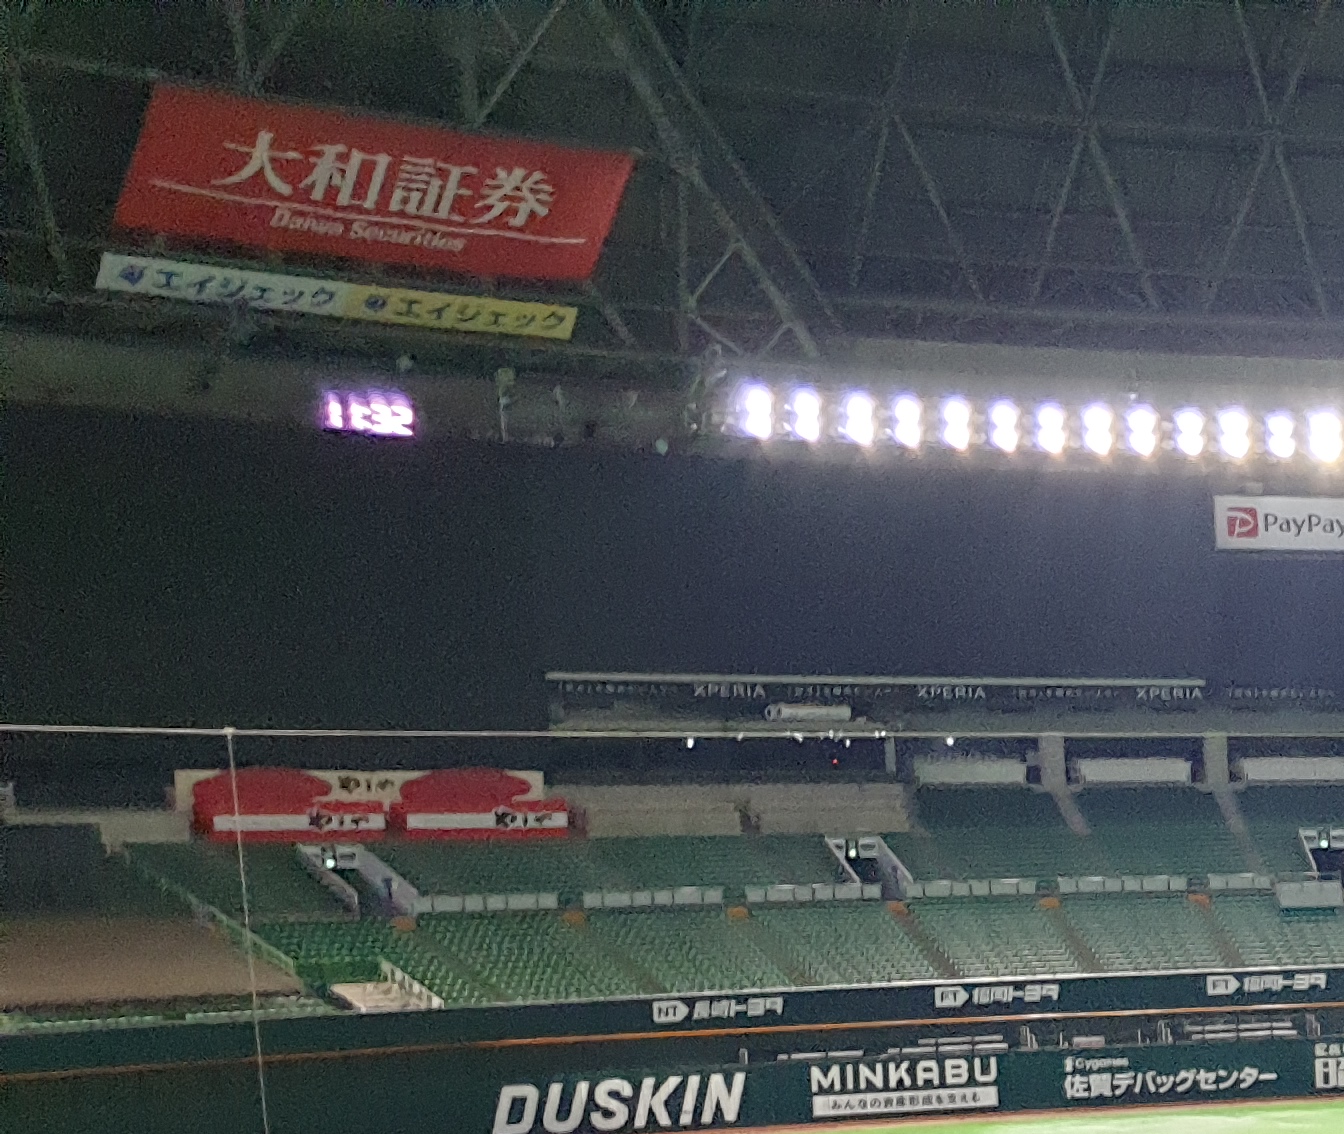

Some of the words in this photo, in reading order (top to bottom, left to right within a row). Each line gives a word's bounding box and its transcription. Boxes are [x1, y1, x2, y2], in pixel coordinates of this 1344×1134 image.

[212, 131, 556, 229] 大和証券
[270, 209, 344, 237] Daiwa
[348, 221, 466, 253] Securities
[153, 269, 339, 307] エイジェック
[396, 299, 570, 333] エイジェック
[810, 1056, 998, 1094] MINKABU
[1064, 1067, 1278, 1099] 佐賀デバッグセンター
